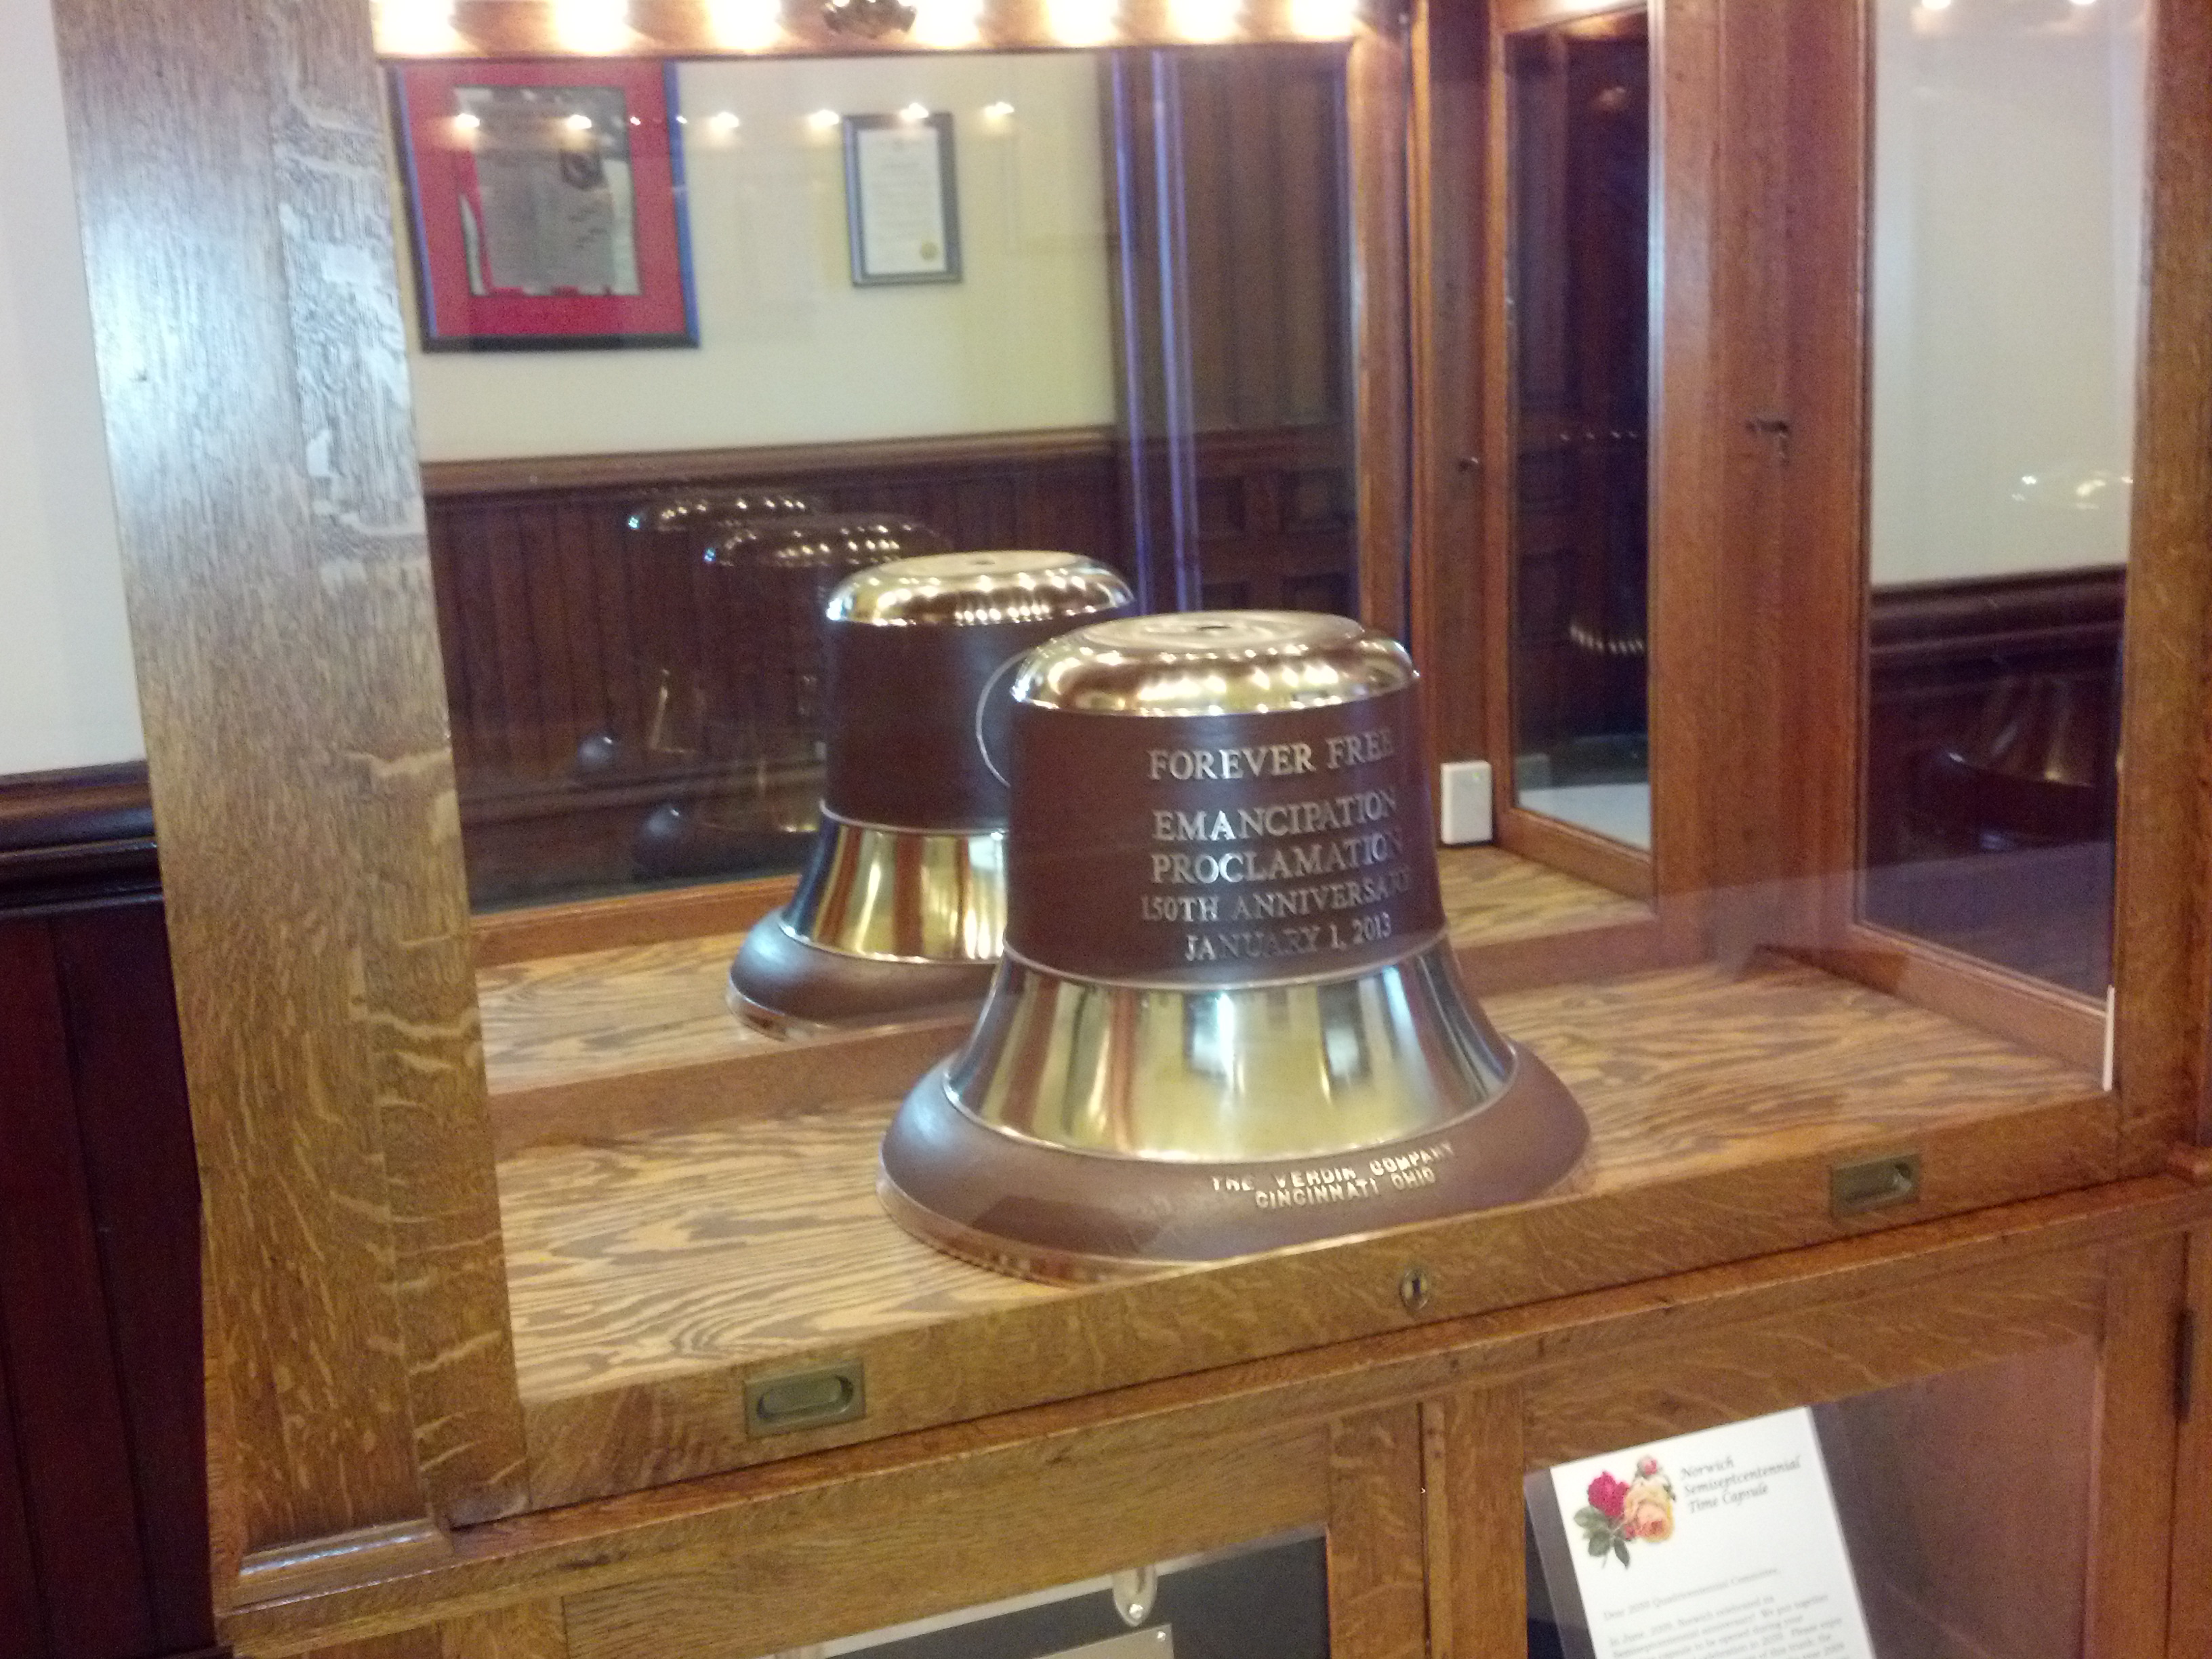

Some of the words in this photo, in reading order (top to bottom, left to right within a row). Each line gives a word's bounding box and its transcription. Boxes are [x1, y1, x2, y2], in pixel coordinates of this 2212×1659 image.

[1148, 743, 1316, 781] FOREVER
[1326, 727, 1395, 769] FREE
[1153, 787, 1397, 841] EMANCIPATION
[1151, 828, 1403, 884] PROCLAMATION
[1141, 895, 1219, 922] 150TH
[1185, 925, 1319, 962] JANUARY
[1351, 912, 1392, 943] 2013
[1210, 1174, 1255, 1192] THE
[1275, 1166, 1357, 1189] VERDIN
[1369, 1142, 1454, 1176] COMPANY
[1256, 1177, 1380, 1208] CINCINNATI
[1390, 1166, 1435, 1191] OHIO
[1680, 1454, 1735, 1480] Norwich
[1687, 1496, 1719, 1515] Time
[1721, 1481, 1769, 1506] Capsule
